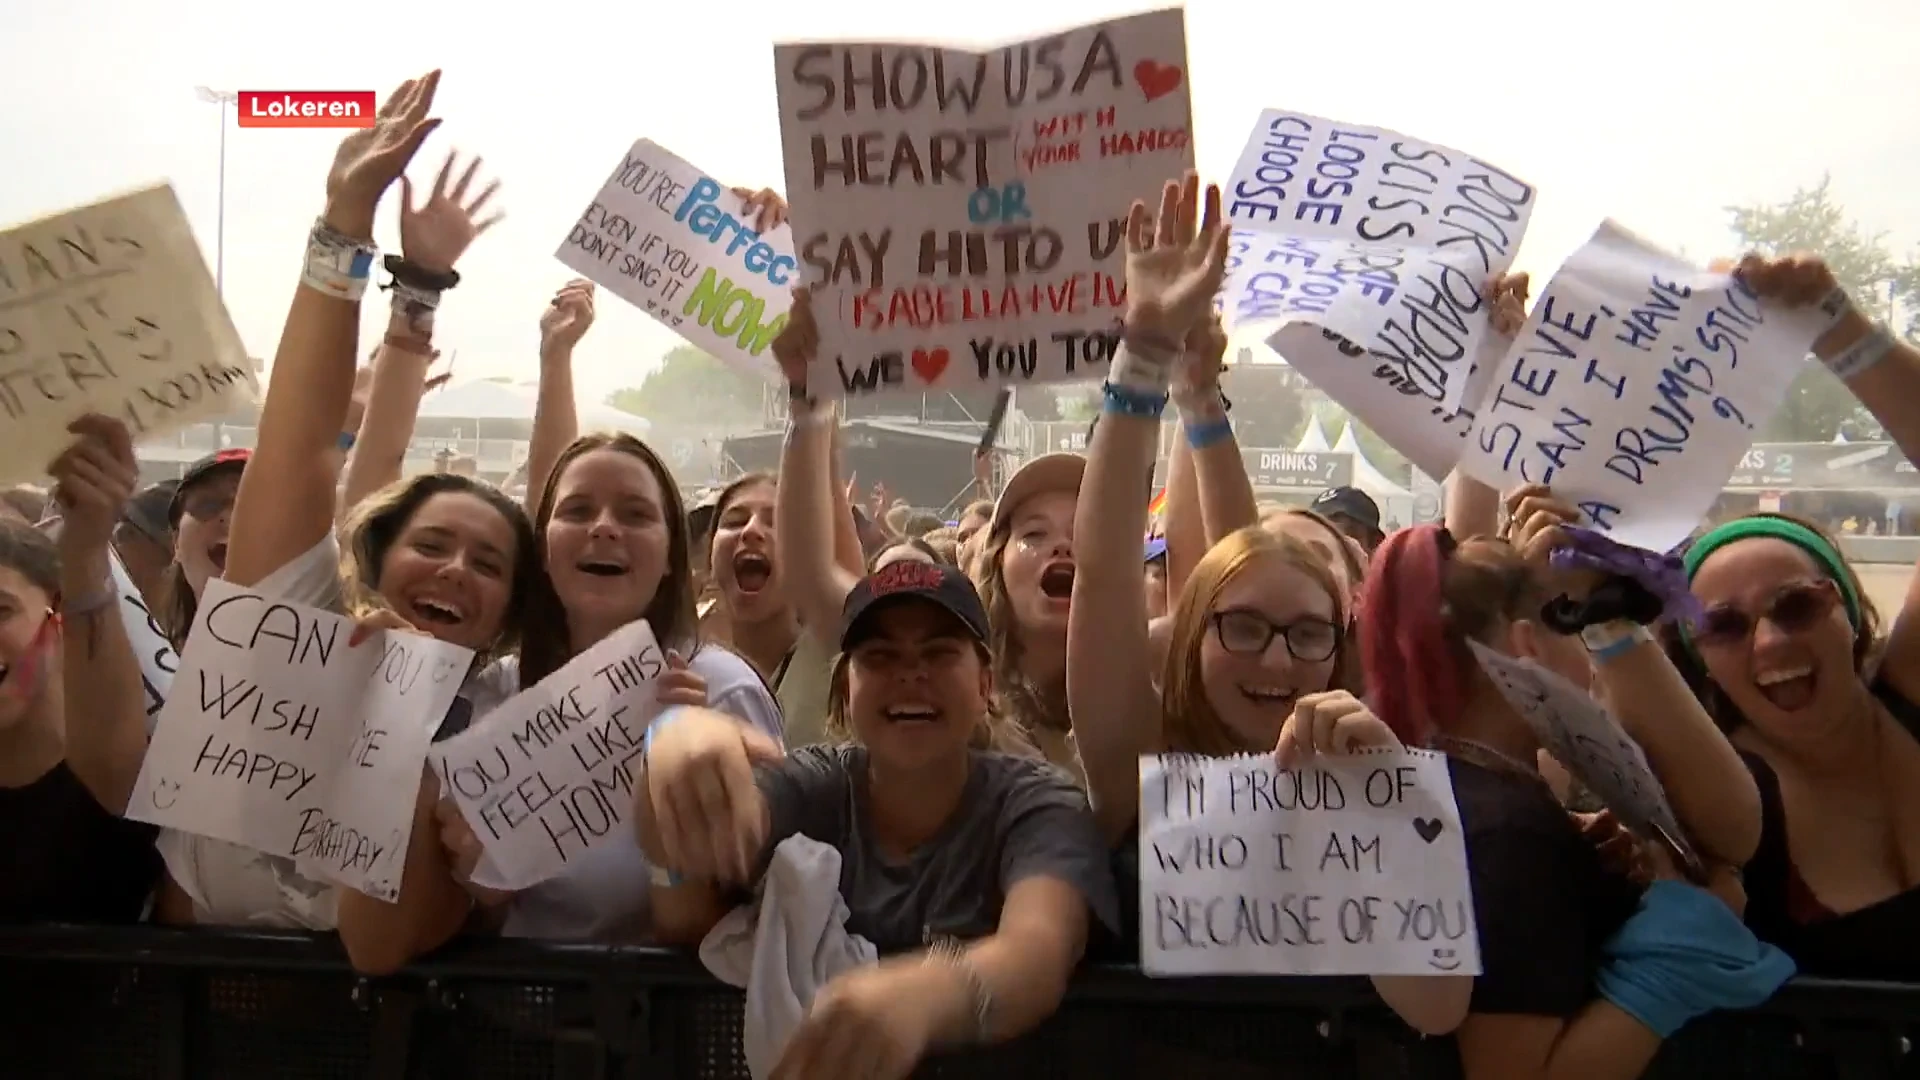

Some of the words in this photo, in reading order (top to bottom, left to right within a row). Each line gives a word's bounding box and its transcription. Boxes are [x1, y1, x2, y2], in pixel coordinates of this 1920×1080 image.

[793, 45, 988, 121] SHOW
[1003, 38, 1064, 105] US
[1070, 30, 1124, 96] A
[810, 128, 1010, 192] HEART
[1229, 115, 1313, 223] CHOOSE
[1294, 127, 1379, 226] LOOSE
[583, 202, 637, 245] EVEN
[639, 232, 663, 255] IF
[662, 242, 699, 280] YOU
[616, 153, 686, 216] YOU'RE
[672, 175, 797, 287] Perfec
[966, 181, 1032, 224] OR
[1436, 156, 1533, 274] ROCK
[800, 228, 893, 292] SAY
[618, 252, 662, 290] SING
[661, 278, 685, 303] IT
[682, 266, 793, 358] NOW
[1366, 259, 1483, 402] PAPER
[1583, 358, 1627, 399] I
[1615, 274, 1692, 352] HAVE
[835, 350, 905, 393] WE
[968, 334, 1039, 380] YOU
[1259, 452, 1319, 472] DRINKS
[1324, 461, 1338, 481] 7
[1577, 499, 1622, 530] A
[206, 594, 340, 668] CAN
[370, 638, 425, 697] YOU
[199, 669, 320, 742] WISH
[511, 684, 598, 760] MAKE
[592, 644, 662, 695] THIS
[193, 734, 317, 801] HAPPY
[479, 770, 569, 840] FEEL
[570, 705, 646, 773] LIKE
[1229, 766, 1346, 816] PROUD
[1365, 766, 1417, 809] OF
[1152, 833, 1248, 874] WHO
[1271, 833, 1294, 873] I
[1319, 832, 1383, 874] AM
[1154, 893, 1327, 951] BECAUSE
[1337, 896, 1382, 946] OF
[1394, 895, 1468, 942] YOU
